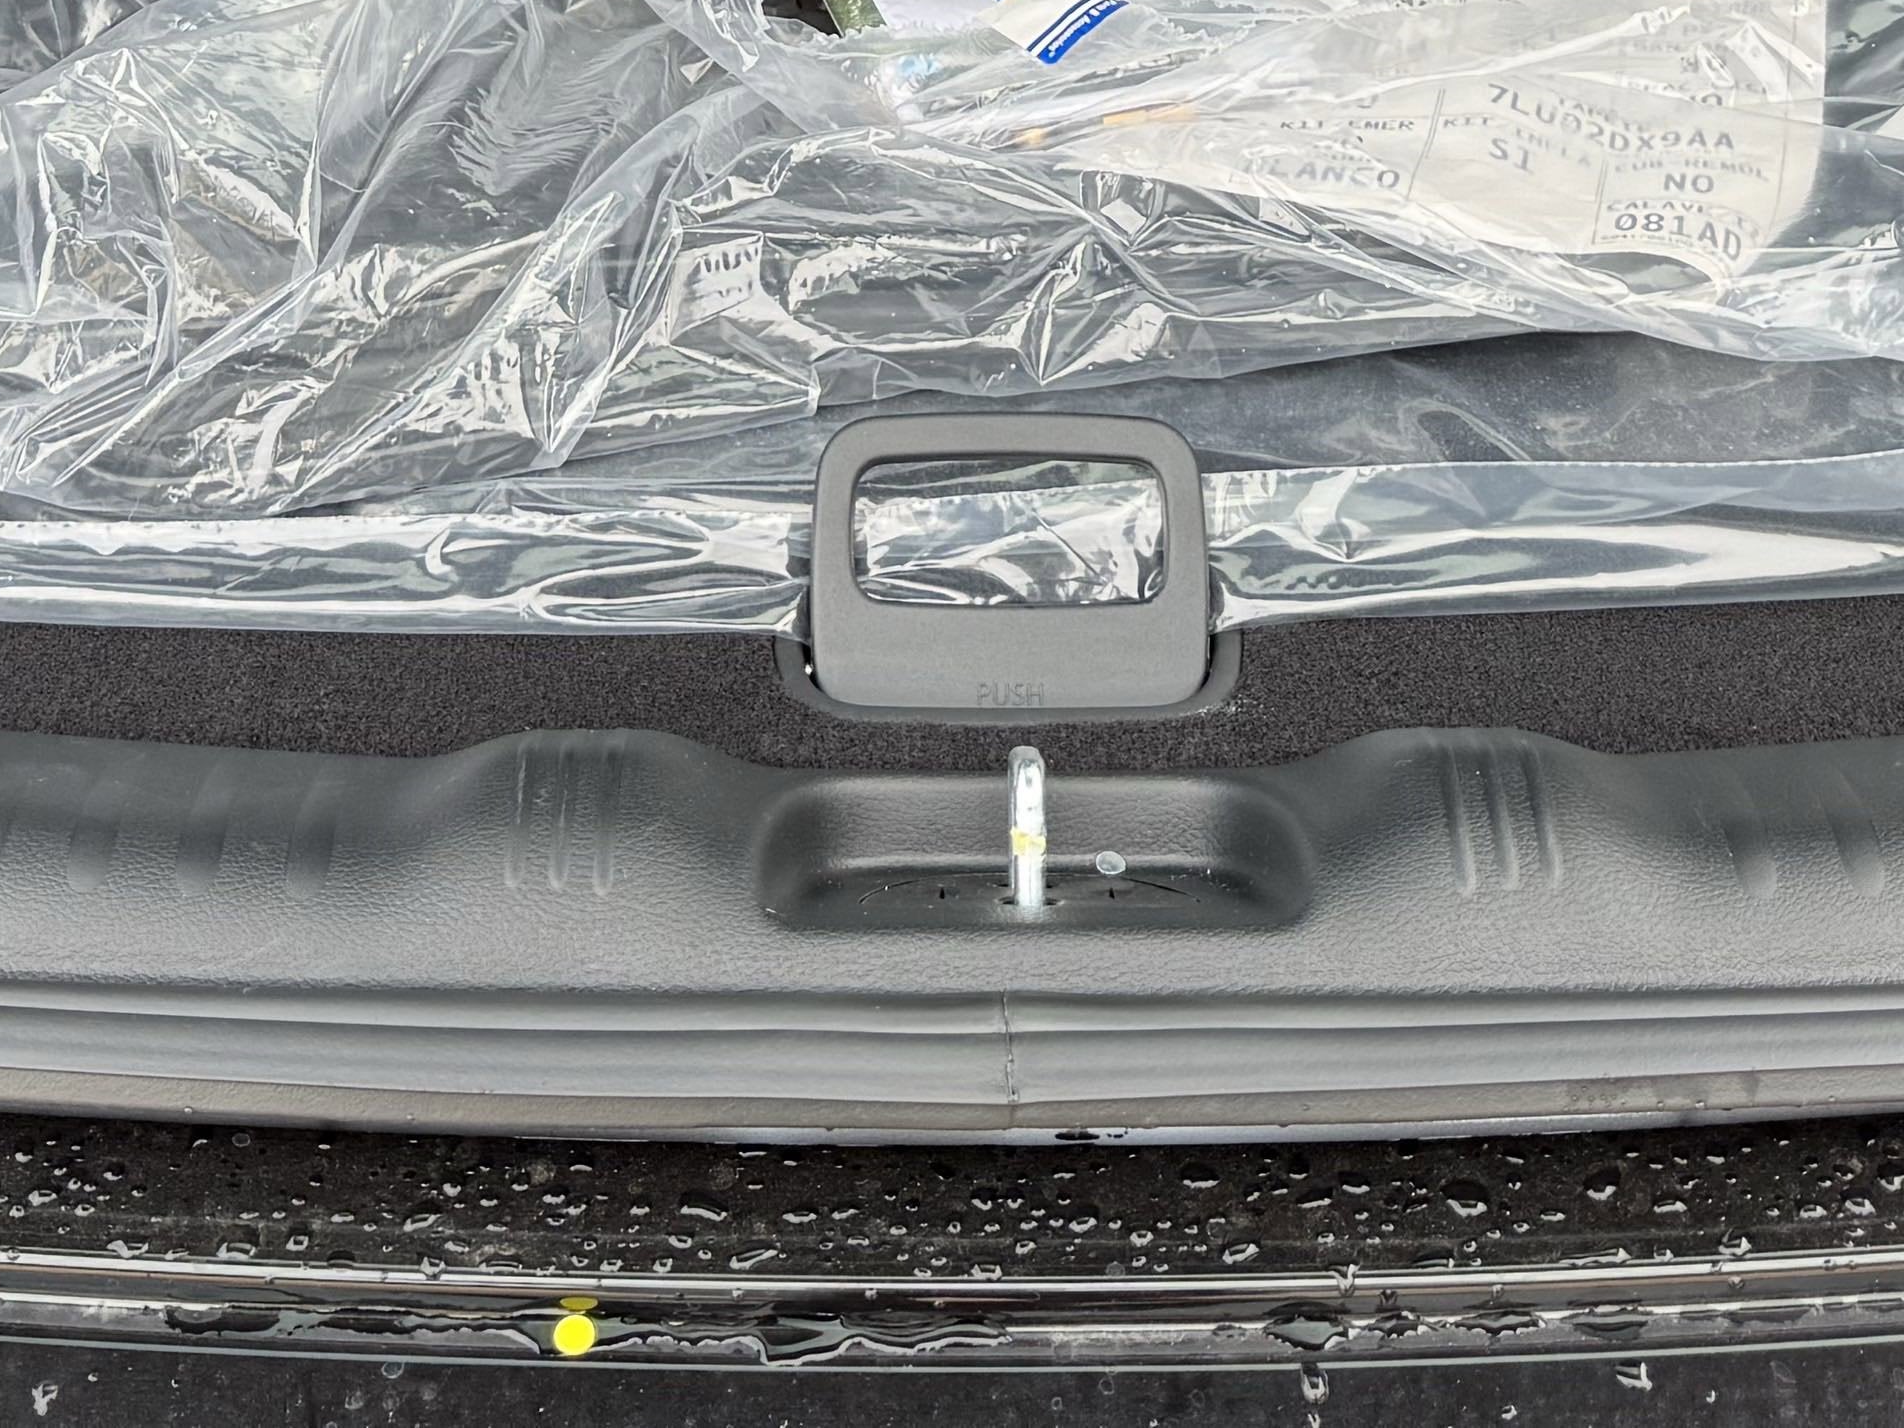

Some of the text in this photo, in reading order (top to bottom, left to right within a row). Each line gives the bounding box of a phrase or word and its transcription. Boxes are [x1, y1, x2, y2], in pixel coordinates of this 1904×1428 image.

[1663, 171, 1715, 194] NO
[1614, 211, 1742, 262] 081AD
[976, 682, 1045, 706] PUSH
